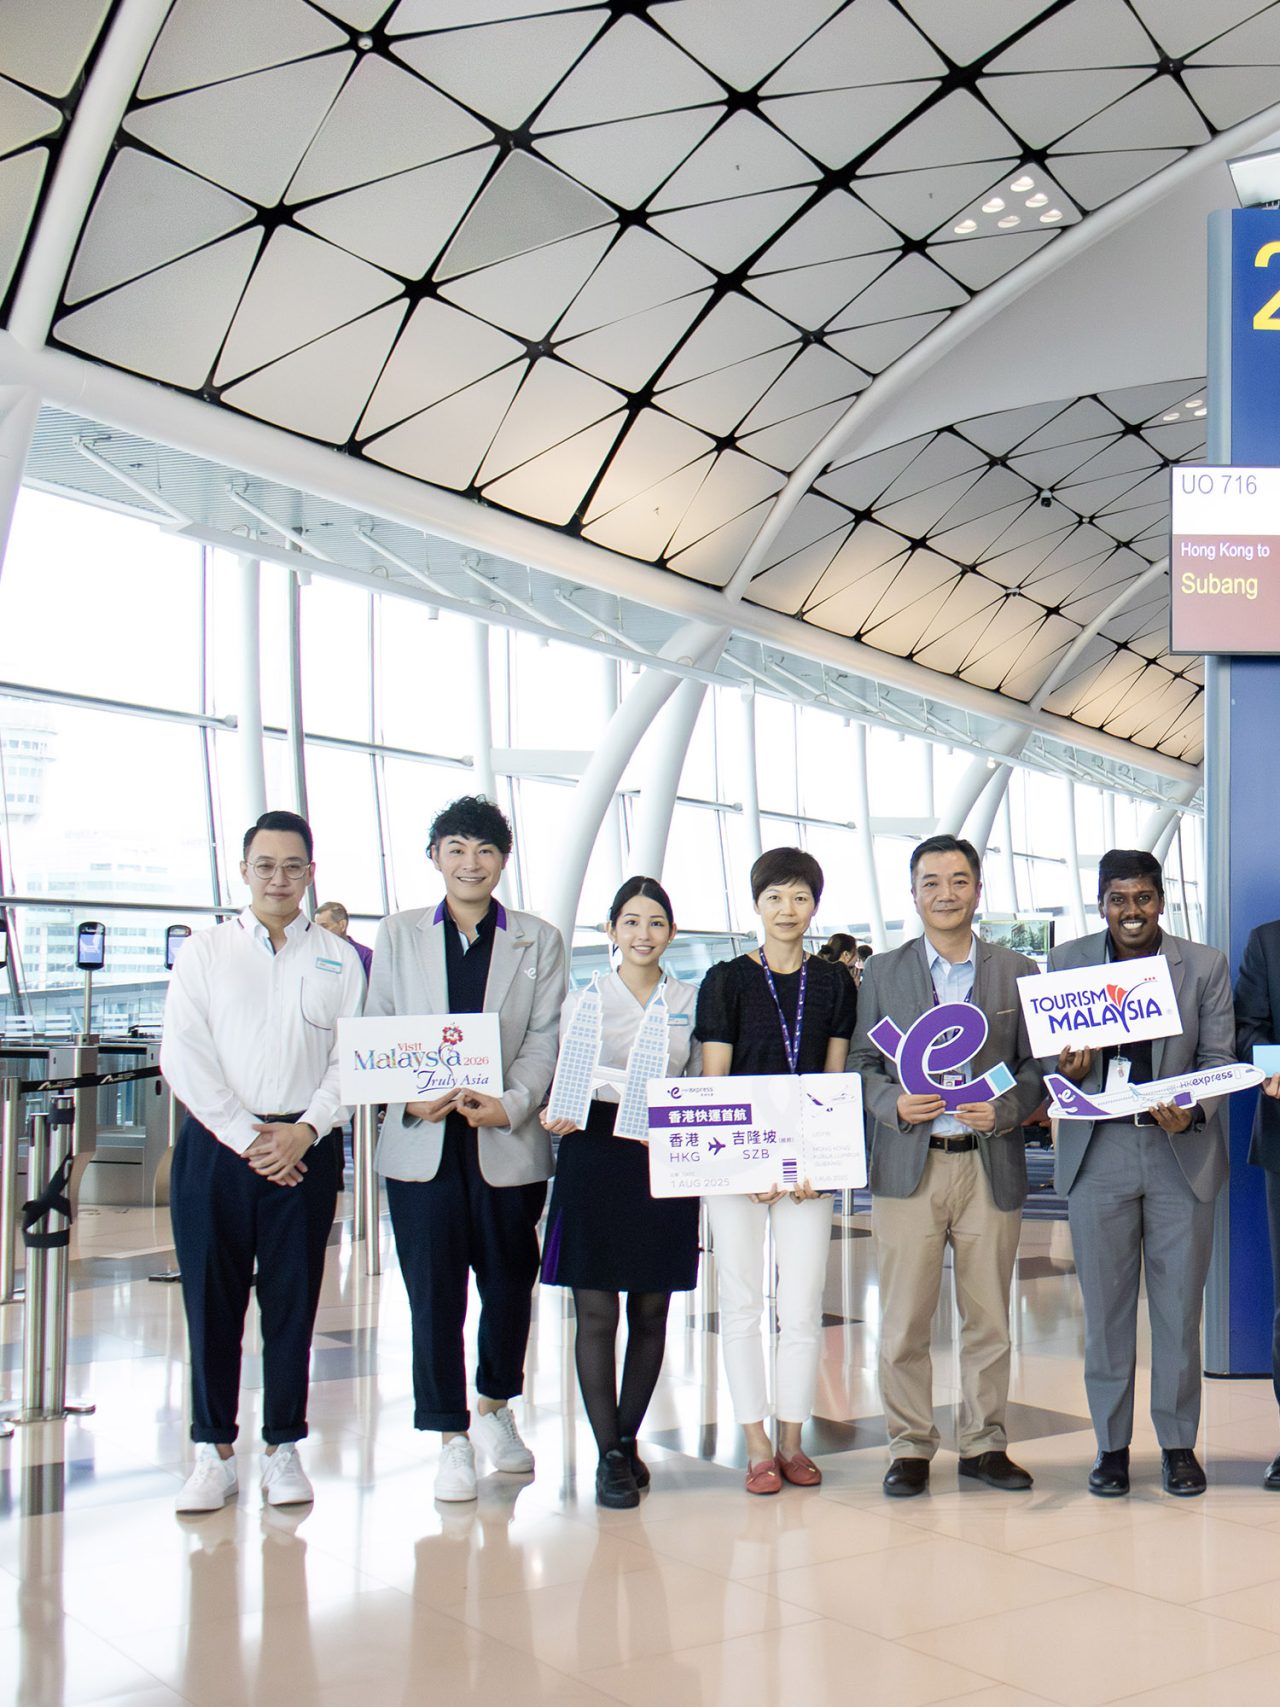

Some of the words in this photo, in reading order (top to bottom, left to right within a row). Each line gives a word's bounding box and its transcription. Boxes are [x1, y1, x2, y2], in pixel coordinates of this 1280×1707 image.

[1181, 475, 1213, 495] UO
[1221, 475, 1257, 495] 716
[1181, 542, 1216, 561] Hong
[1219, 542, 1254, 561] Kong
[1256, 544, 1270, 558] to
[1181, 572, 1258, 600] Subang
[1030, 987, 1108, 1014] TOURISM
[1048, 998, 1162, 1034] MALAYSIA
[398, 1042, 422, 1051] Visit
[354, 1041, 462, 1074] Malaysia
[463, 1056, 489, 1066] 2026
[416, 1070, 457, 1091] Truly
[460, 1074, 489, 1086] Asia
[668, 1109, 747, 1124] 香港快運首航
[669, 1133, 699, 1148] 香港
[732, 1130, 777, 1146] 吉隆坡
[670, 1152, 700, 1163] HKG
[743, 1149, 770, 1160] SZB
[679, 1179, 702, 1188] AUG
[704, 1178, 730, 1187] 2025
